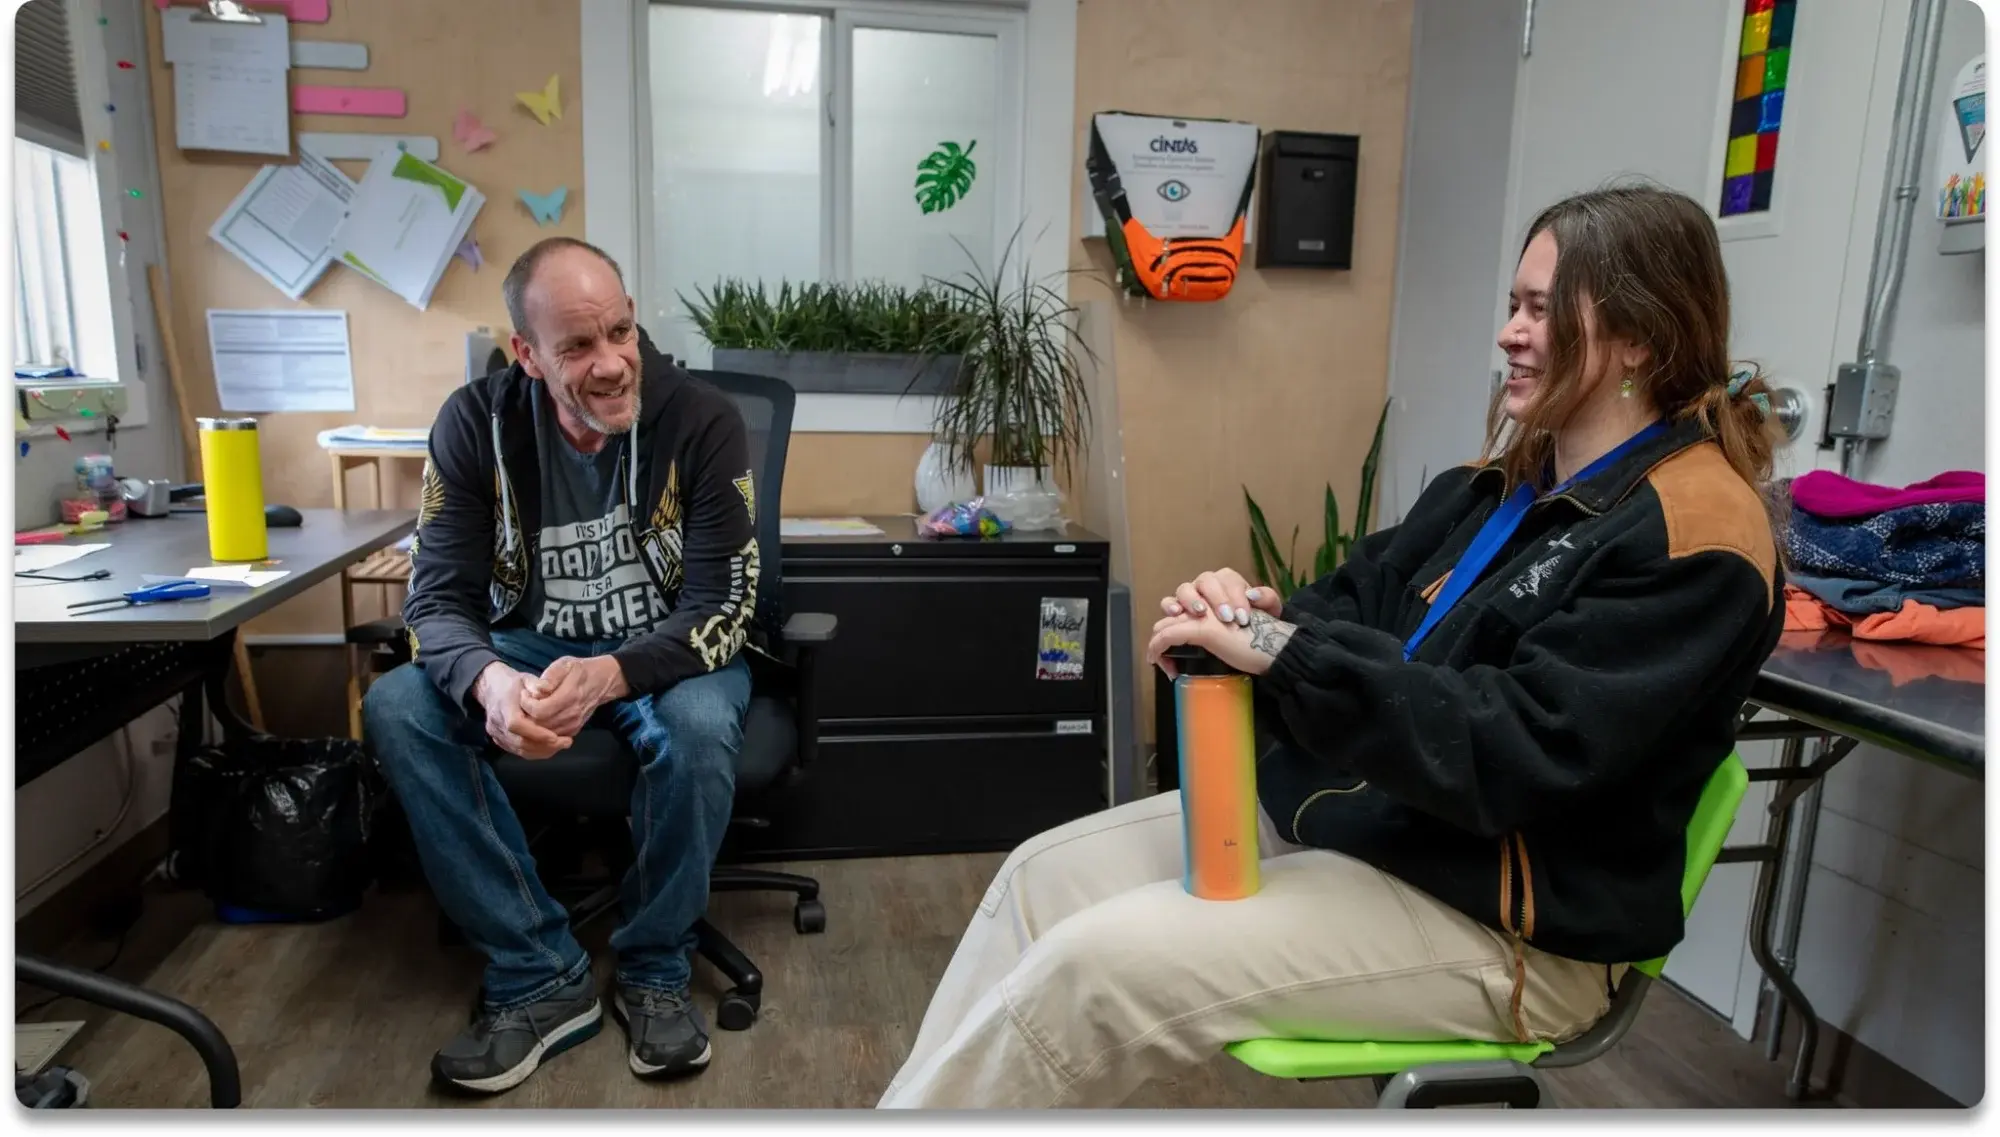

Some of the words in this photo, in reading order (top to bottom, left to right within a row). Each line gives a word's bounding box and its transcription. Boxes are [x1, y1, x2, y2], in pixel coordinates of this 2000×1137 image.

[575, 523, 596, 539] IT'S
[581, 581, 603, 598] IT'S
[604, 575, 613, 590] A
[536, 585, 669, 638] FATHER
[1041, 602, 1067, 616] The
